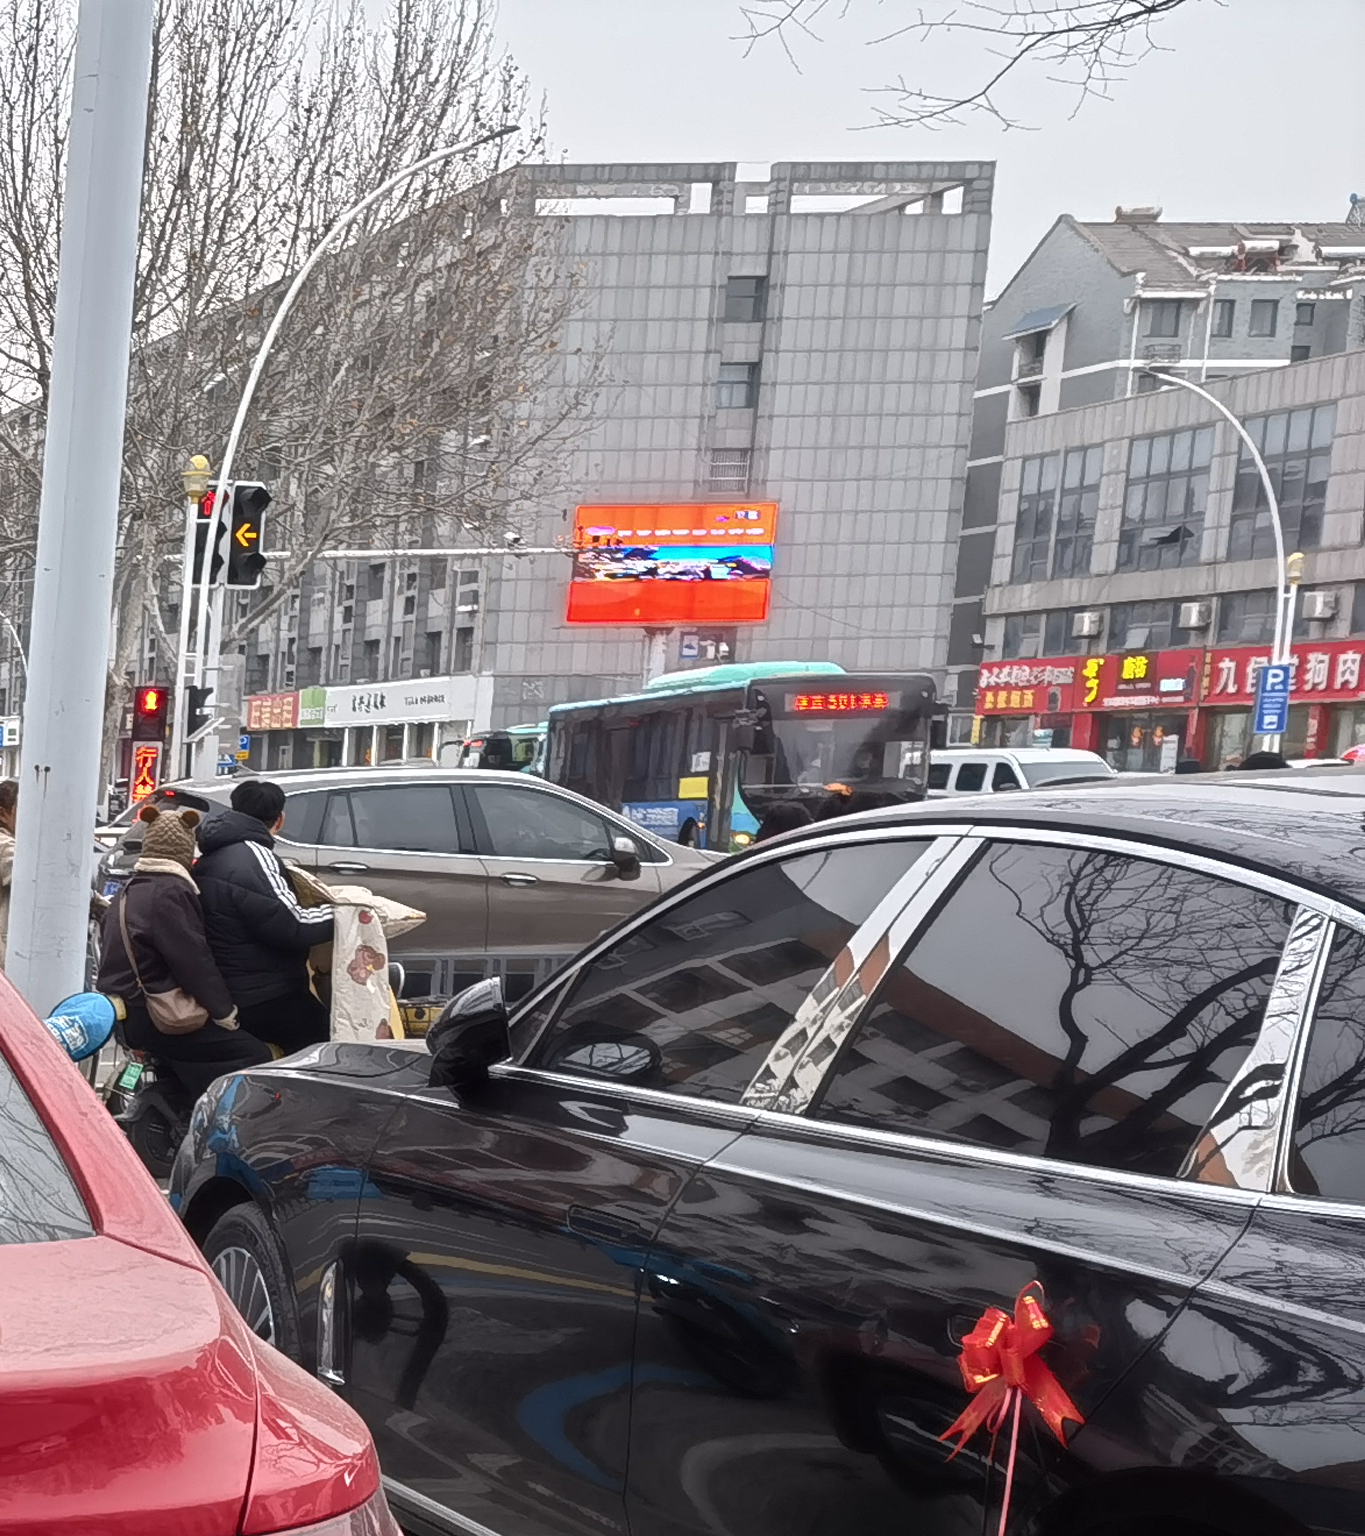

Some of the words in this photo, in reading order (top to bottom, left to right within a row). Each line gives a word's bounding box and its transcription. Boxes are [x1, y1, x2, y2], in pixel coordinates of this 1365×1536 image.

[1213, 649, 1363, 696] 九狗肉
[1266, 668, 1285, 691] P
